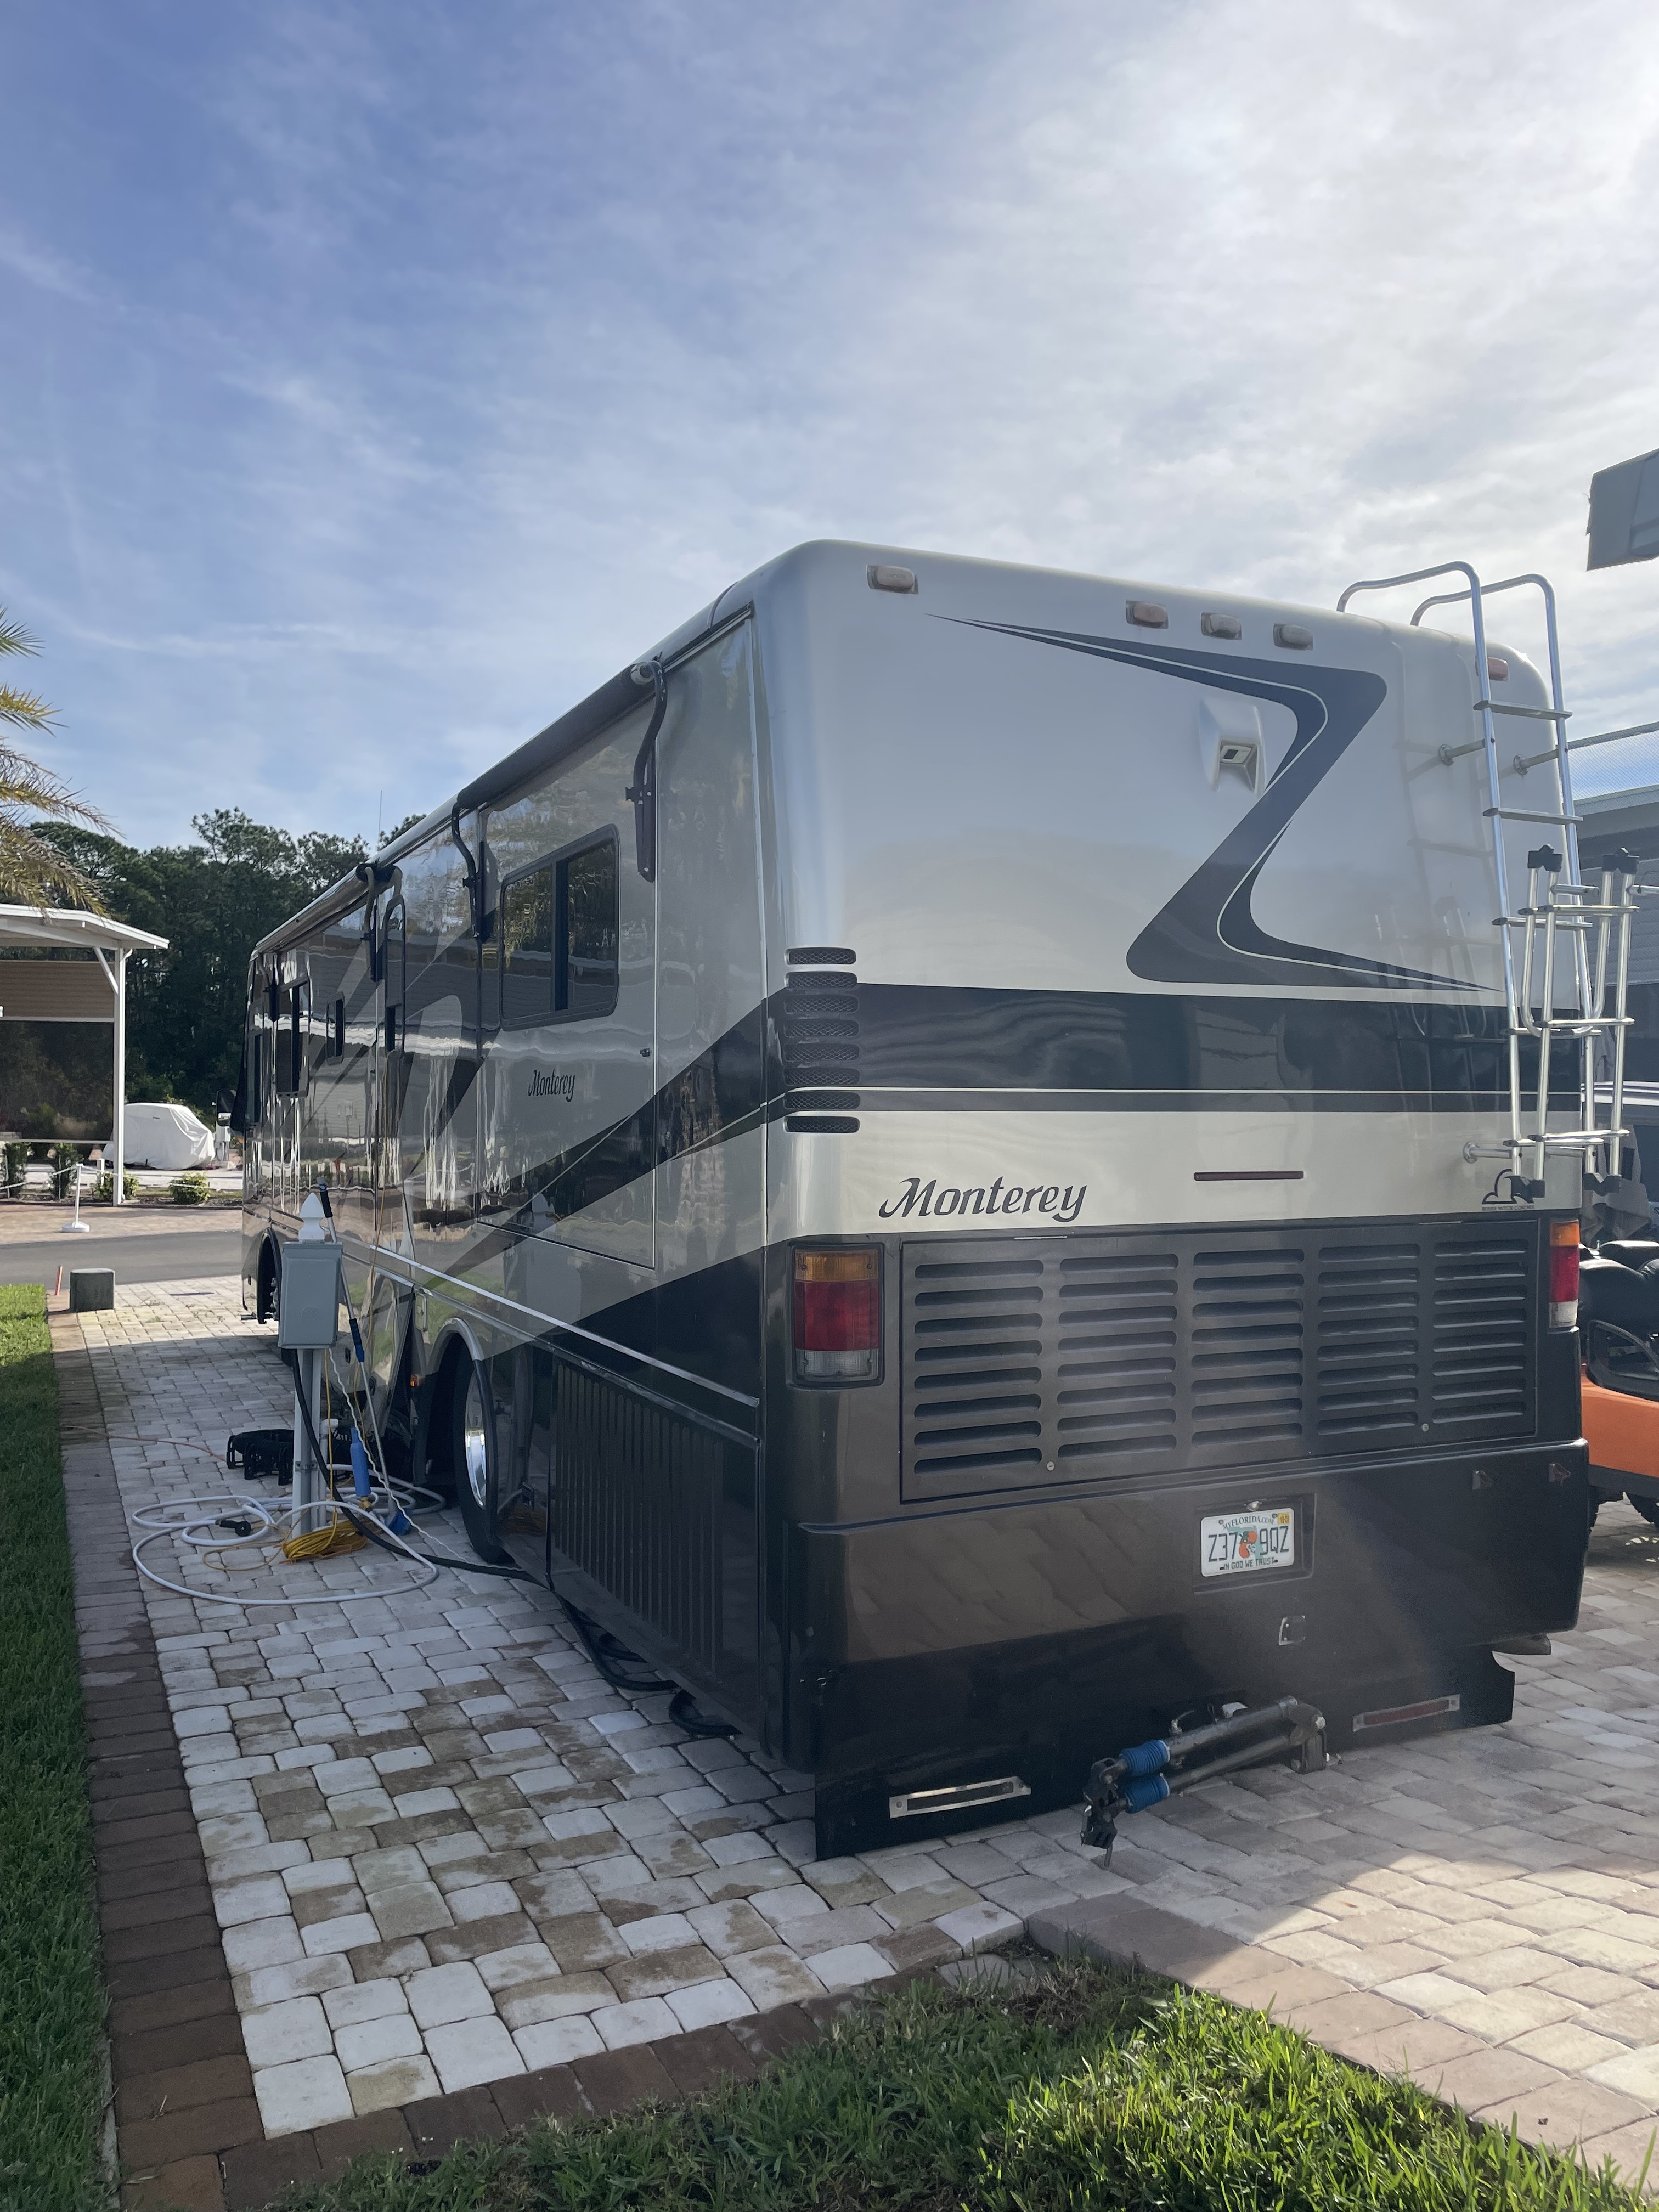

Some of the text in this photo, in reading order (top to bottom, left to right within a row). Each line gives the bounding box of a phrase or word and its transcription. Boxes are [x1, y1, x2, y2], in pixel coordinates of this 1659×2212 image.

[528, 1069, 575, 1103] Monterey
[879, 1176, 1087, 1222] Monterey
[1223, 1516, 1274, 1529] MYFLORIDA.COM
[1208, 1526, 1289, 1562] Z37 9QZ
[1231, 1561, 1243, 1569] GOD
[1245, 1559, 1254, 1568] WE
[1255, 1556, 1274, 1566] TRUST
